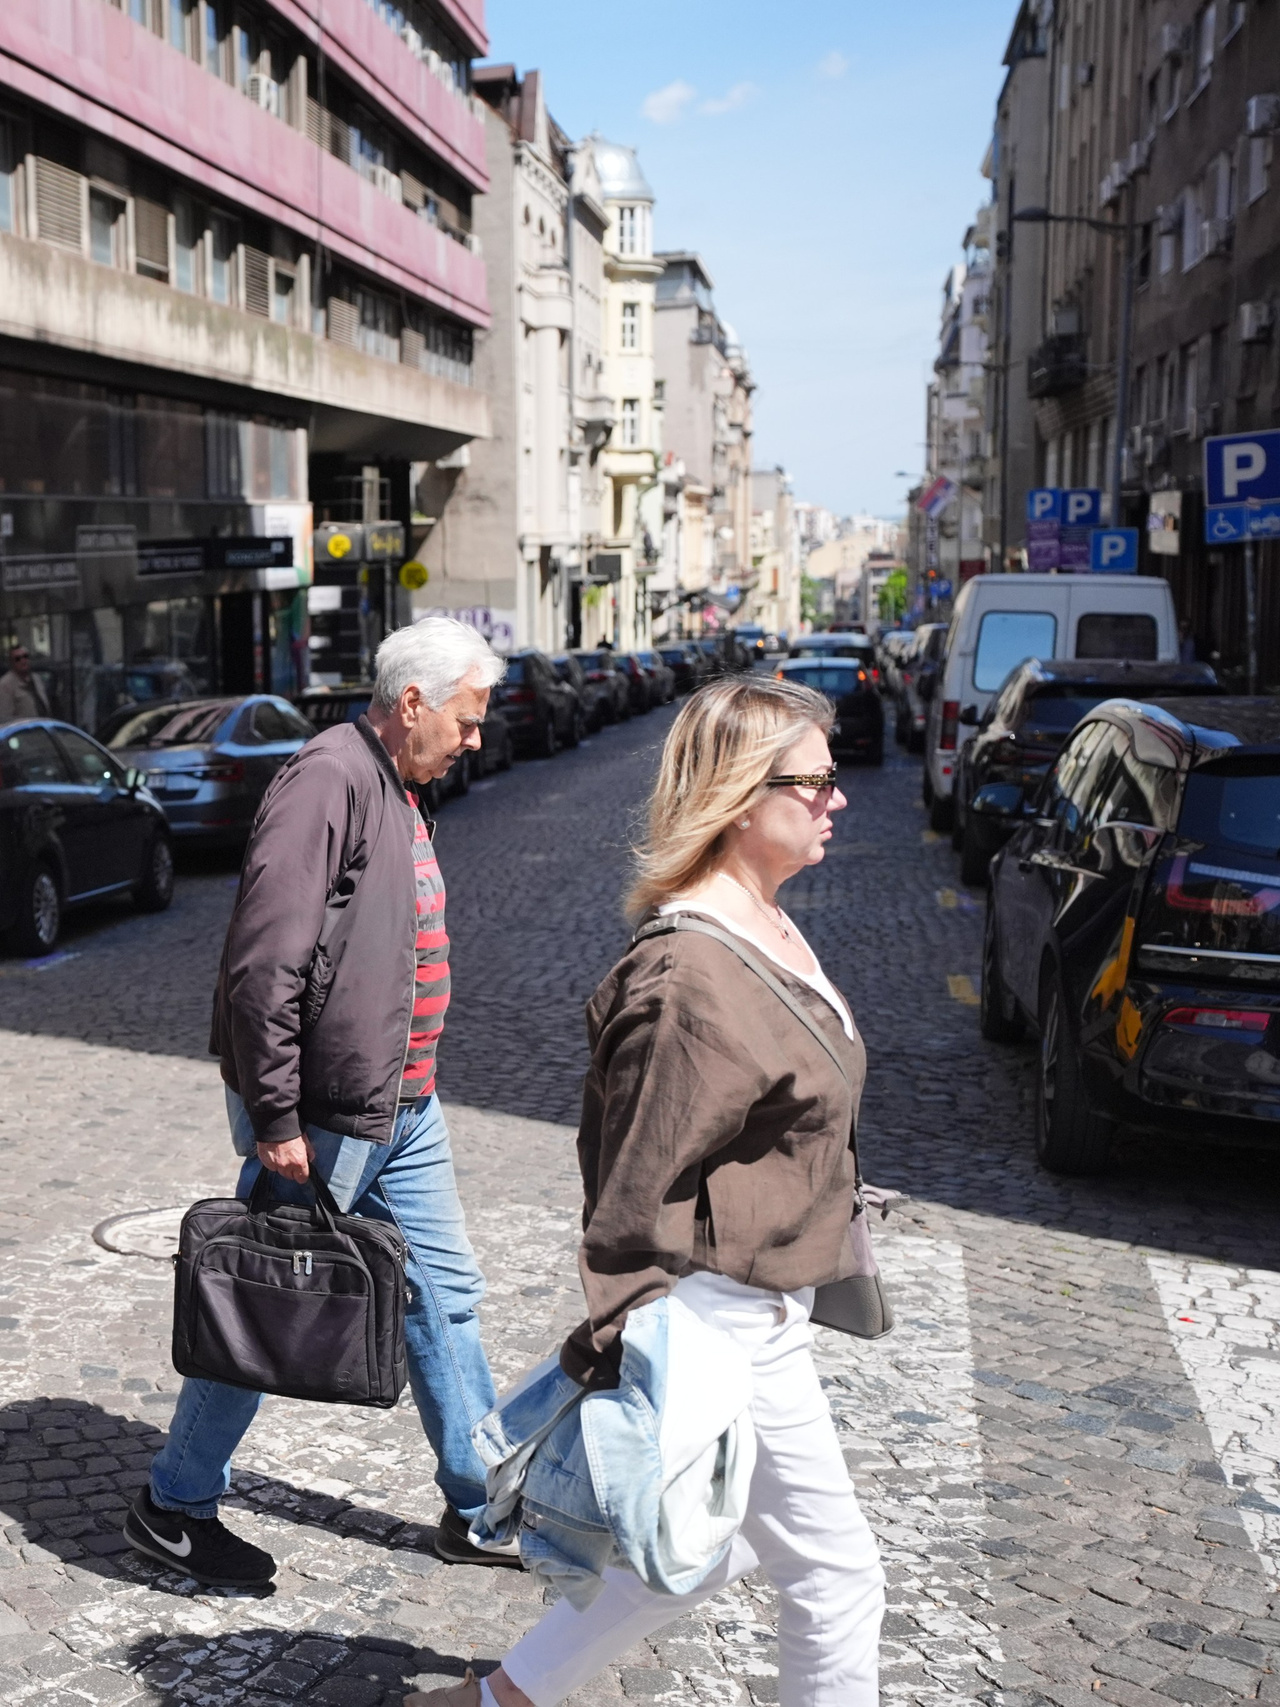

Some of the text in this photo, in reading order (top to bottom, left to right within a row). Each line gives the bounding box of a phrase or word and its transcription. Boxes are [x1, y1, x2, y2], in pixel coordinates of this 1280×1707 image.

[1223, 442, 1267, 497] P
[1034, 491, 1053, 519] P
[1068, 492, 1093, 523] P
[1101, 534, 1127, 566] P
